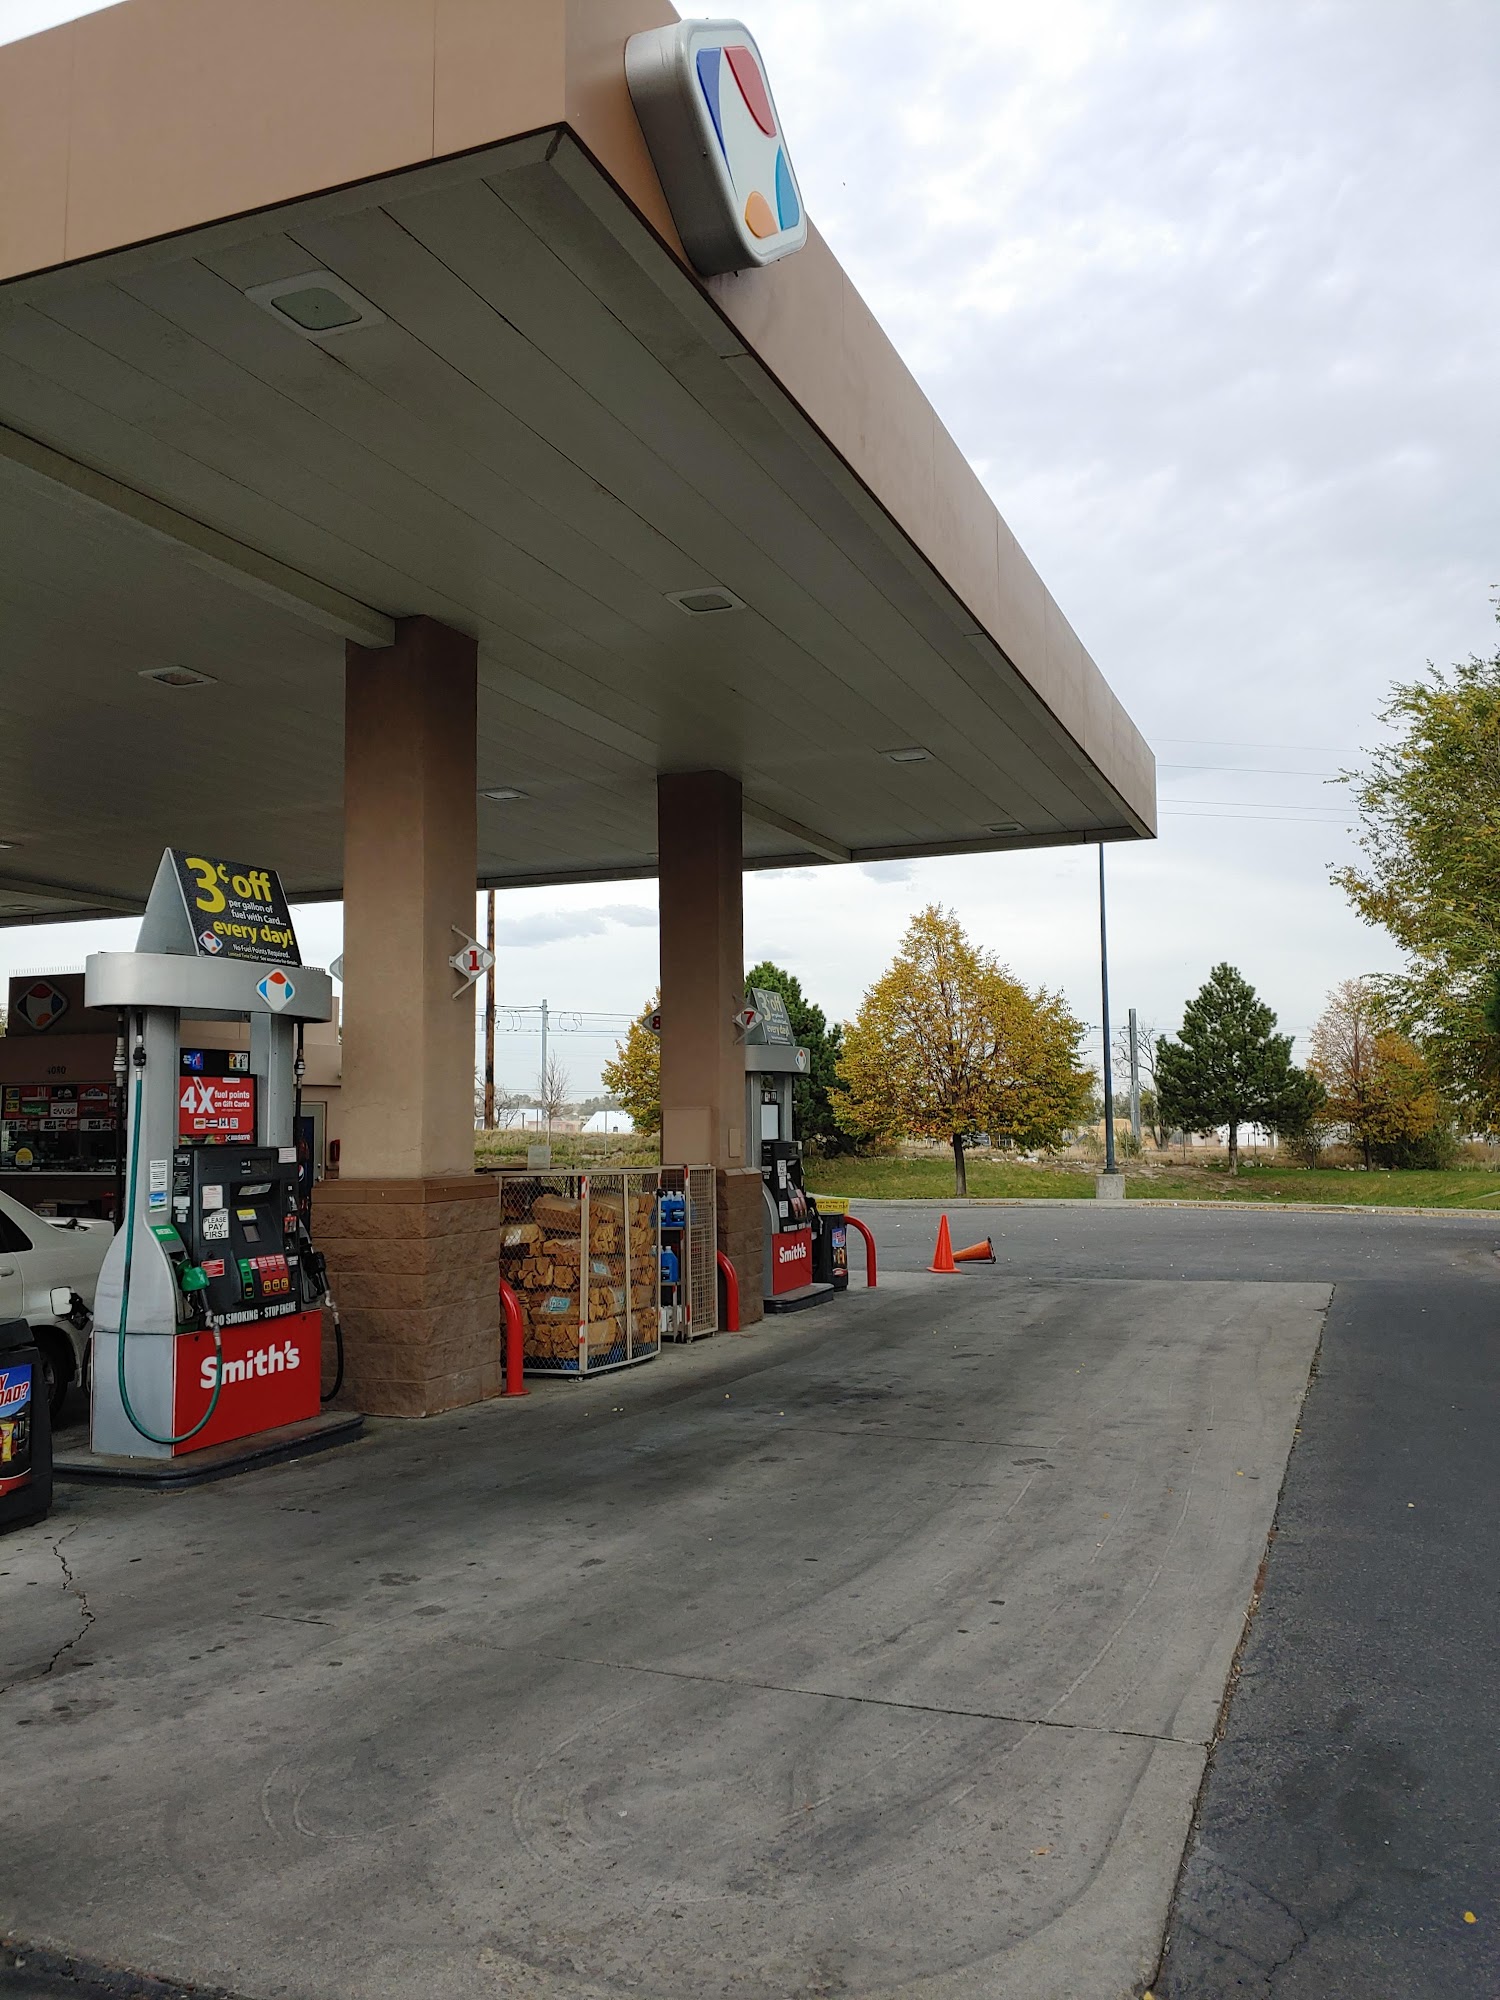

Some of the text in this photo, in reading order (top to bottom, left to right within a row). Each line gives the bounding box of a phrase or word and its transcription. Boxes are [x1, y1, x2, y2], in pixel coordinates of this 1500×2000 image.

[232, 871, 273, 902] off
[228, 900, 273, 914] per gallon of
[231, 909, 245, 919] fuel
[246, 912, 263, 922] with
[213, 920, 294, 949] every day!
[233, 943, 241, 951] No
[241, 944, 252, 953] Fuel
[252, 947, 267, 956] Points
[469, 951, 480, 970] 1
[743, 1011, 755, 1025] 7
[180, 1077, 250, 1114] 4X fuel points
[222, 1100, 233, 1108] Gift
[234, 1100, 250, 1108] Cards
[204, 1216, 227, 1224] PLEASE
[208, 1223, 223, 1231] PAY
[205, 1230, 228, 1238] FIRST
[779, 1242, 807, 1264] Smith's
[225, 1308, 259, 1325] SMOKING
[264, 1305, 279, 1318] STOP
[279, 1301, 296, 1315] ENGINE
[200, 1340, 300, 1389] Smith's
